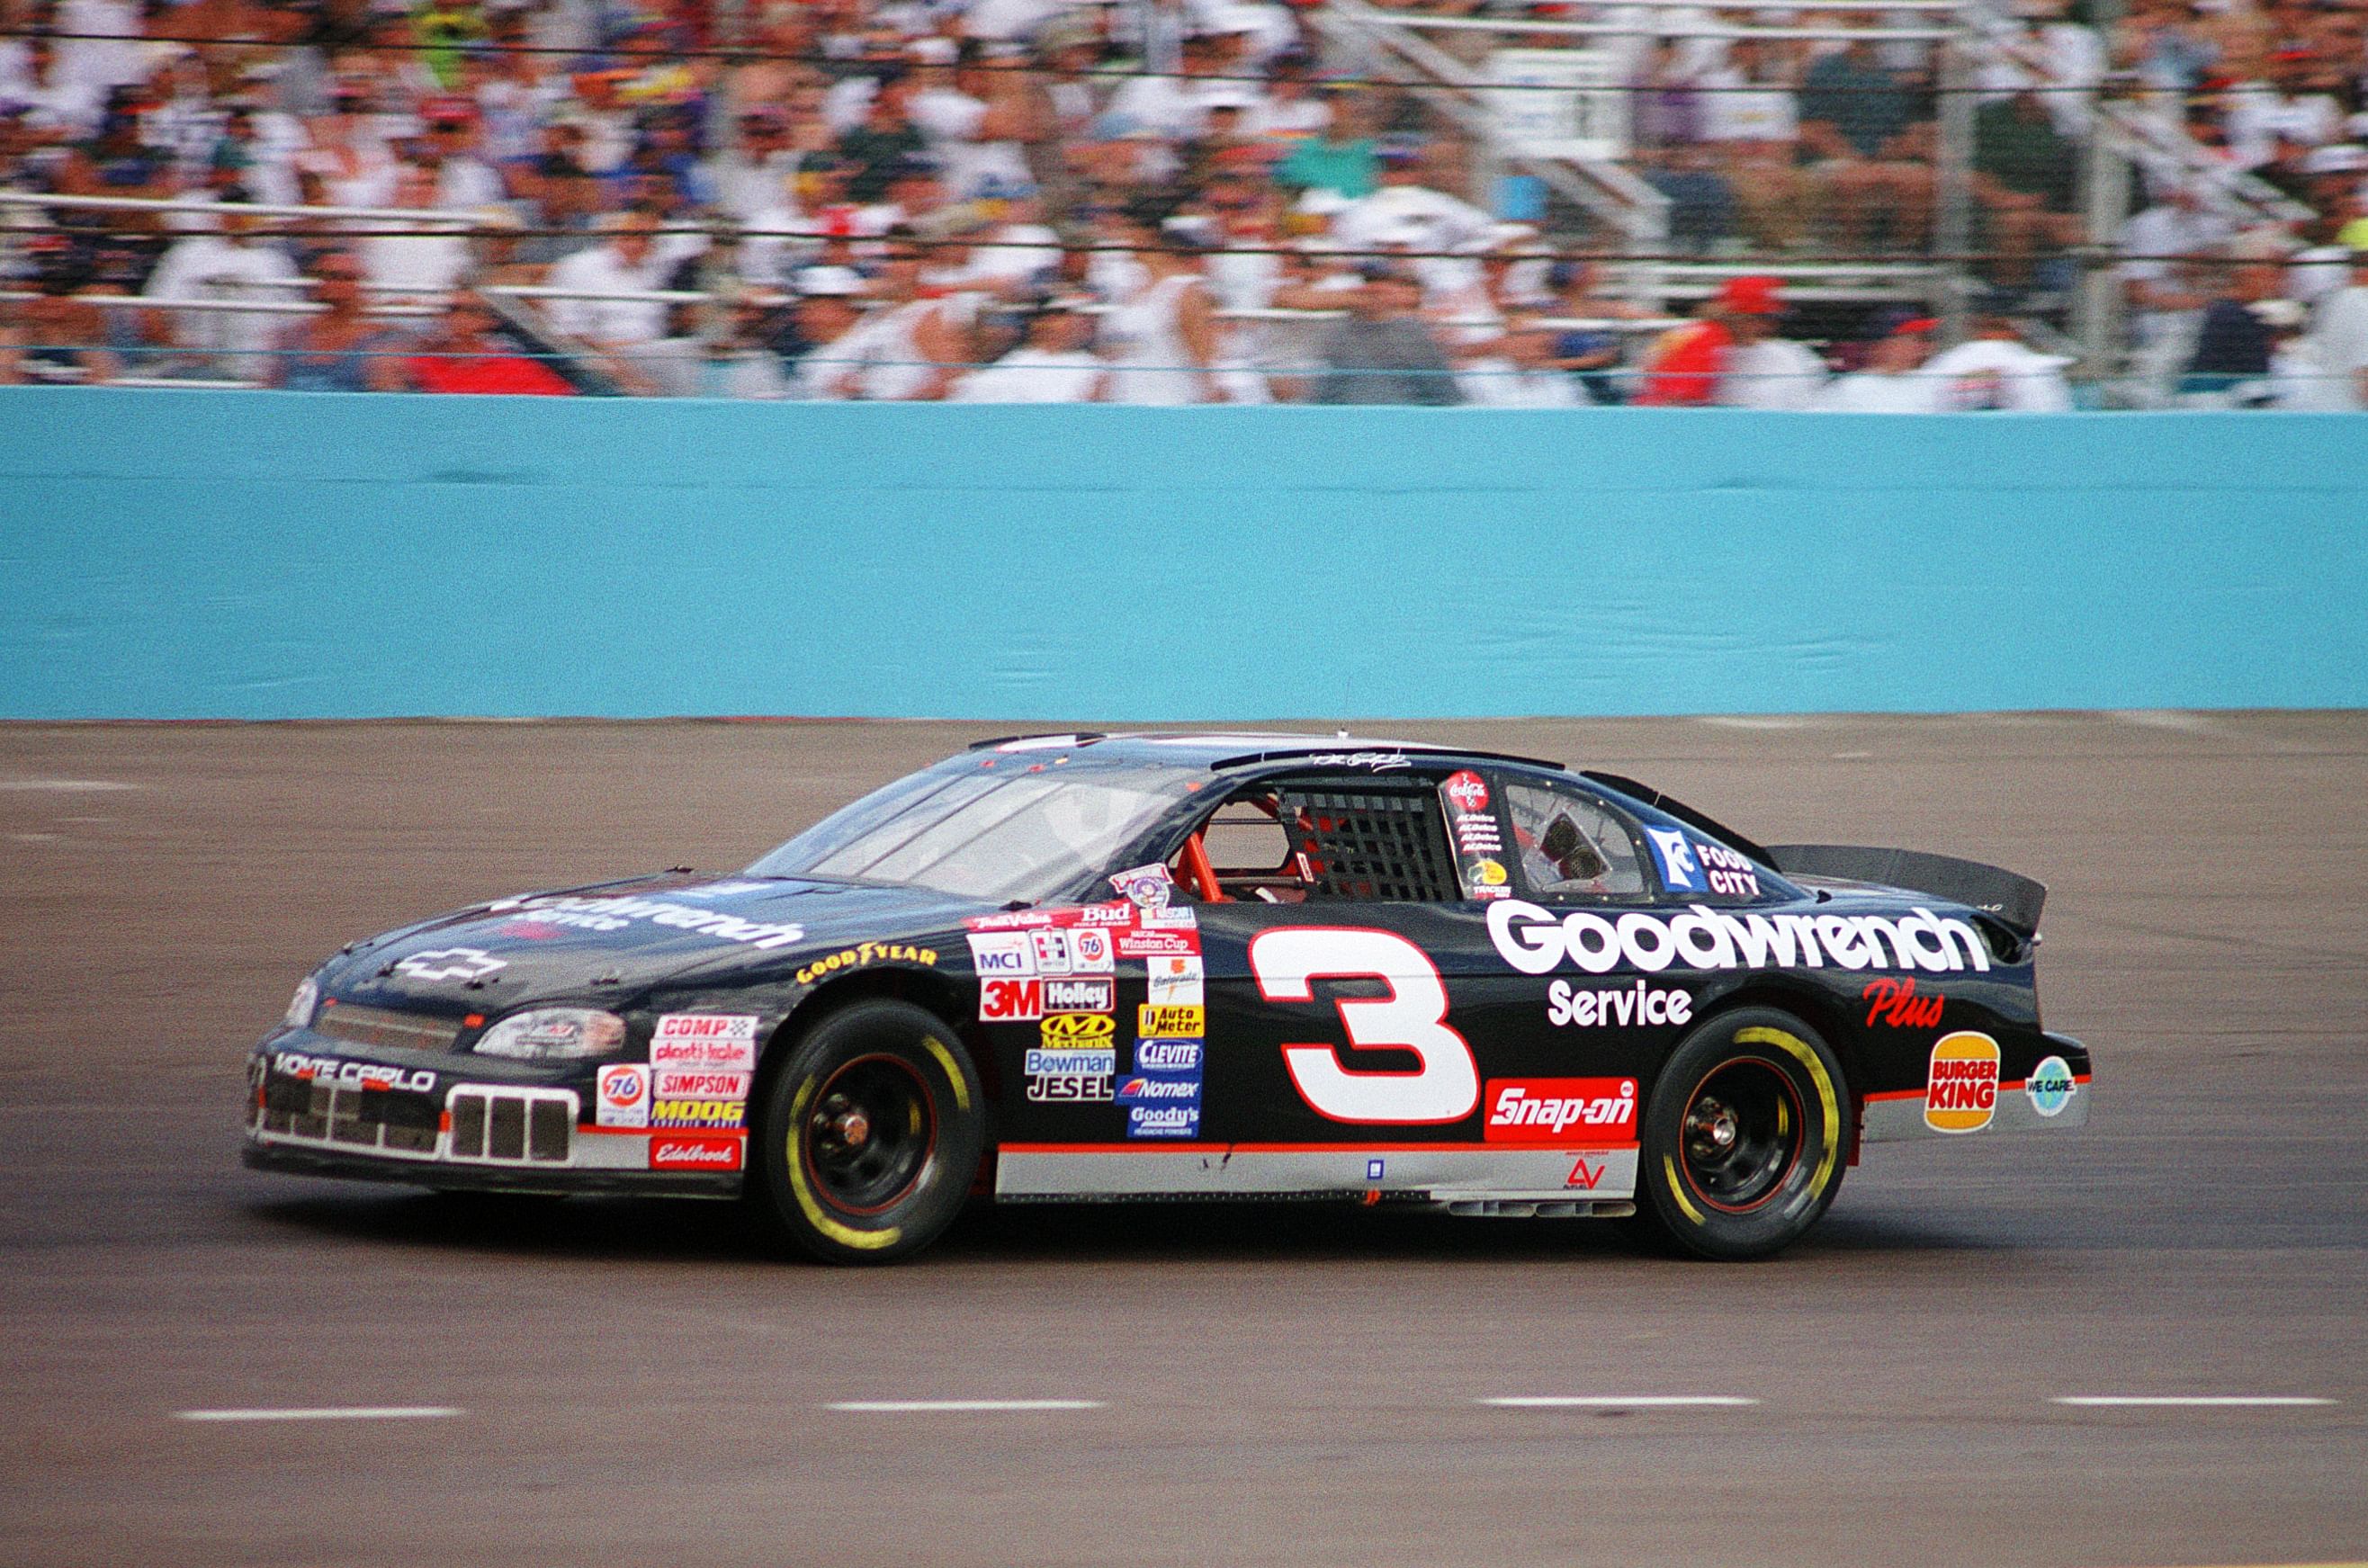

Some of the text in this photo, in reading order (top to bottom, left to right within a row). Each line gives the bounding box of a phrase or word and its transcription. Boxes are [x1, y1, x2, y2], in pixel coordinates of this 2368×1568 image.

[1695, 843, 1753, 871] FOOD
[1709, 870, 1761, 896] CITY
[1081, 903, 1131, 922] Bud
[1083, 939, 1099, 954] 76
[1119, 937, 1188, 952] Winston Cup
[1486, 899, 1990, 973] Goodwrench
[980, 953, 1022, 969] MCI
[983, 980, 1040, 1017] 3M
[1048, 982, 1108, 1009] Holley
[1548, 980, 1693, 1026] Service
[1862, 976, 1944, 1027] Plus
[1159, 1008, 1194, 1019] Auto
[664, 1019, 729, 1035] COMP
[1155, 1020, 1200, 1035] Meter
[1249, 926, 1481, 1125] 3
[1041, 1035, 1114, 1049] Mechanix
[1139, 1040, 1199, 1063] CLEVITE
[1028, 1051, 1114, 1073] Bowman
[1933, 1061, 1997, 1080] BURGER
[610, 1076, 637, 1096] 76
[662, 1075, 740, 1094] SIMPSON
[1028, 1076, 1114, 1099] JESEL
[1138, 1079, 1199, 1098] Nomex
[1928, 1081, 1996, 1109] KING
[2027, 1079, 2074, 1093] WE CARE
[650, 1100, 747, 1121] MOOG
[1131, 1107, 1199, 1126] Goody's
[1490, 1088, 1635, 1133] Snap-on
[655, 1142, 732, 1163] Edelbrock
